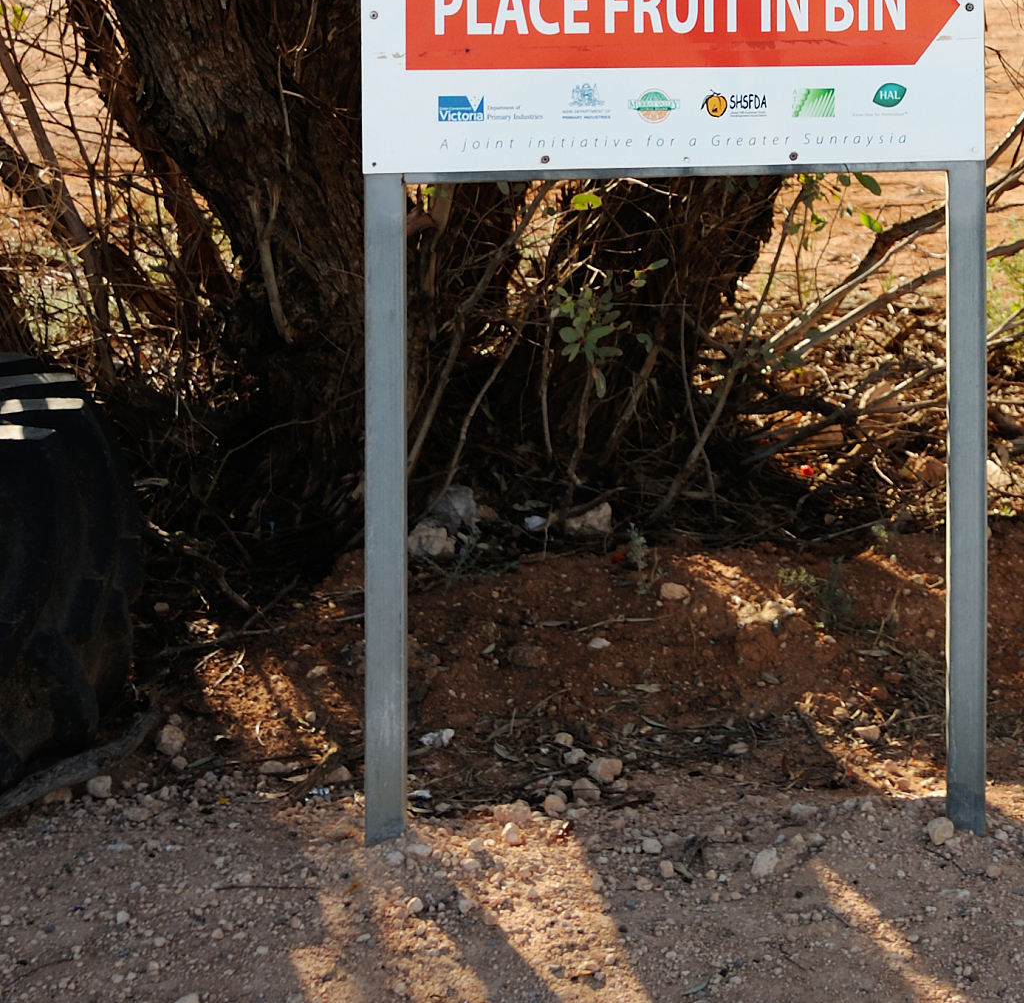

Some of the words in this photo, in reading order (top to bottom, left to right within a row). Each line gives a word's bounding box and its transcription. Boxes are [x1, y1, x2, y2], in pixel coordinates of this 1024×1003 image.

[880, 91, 901, 100] HAL
[730, 94, 767, 109] SHSFDA
[440, 110, 483, 121] Victoria
[487, 113, 511, 121] Primary
[440, 139, 449, 149] A
[461, 138, 514, 152] joint
[528, 137, 633, 148] initiative
[647, 135, 675, 147] for
[689, 137, 697, 146] a
[711, 134, 790, 146] Greater
[803, 133, 907, 147] Sunraysia
